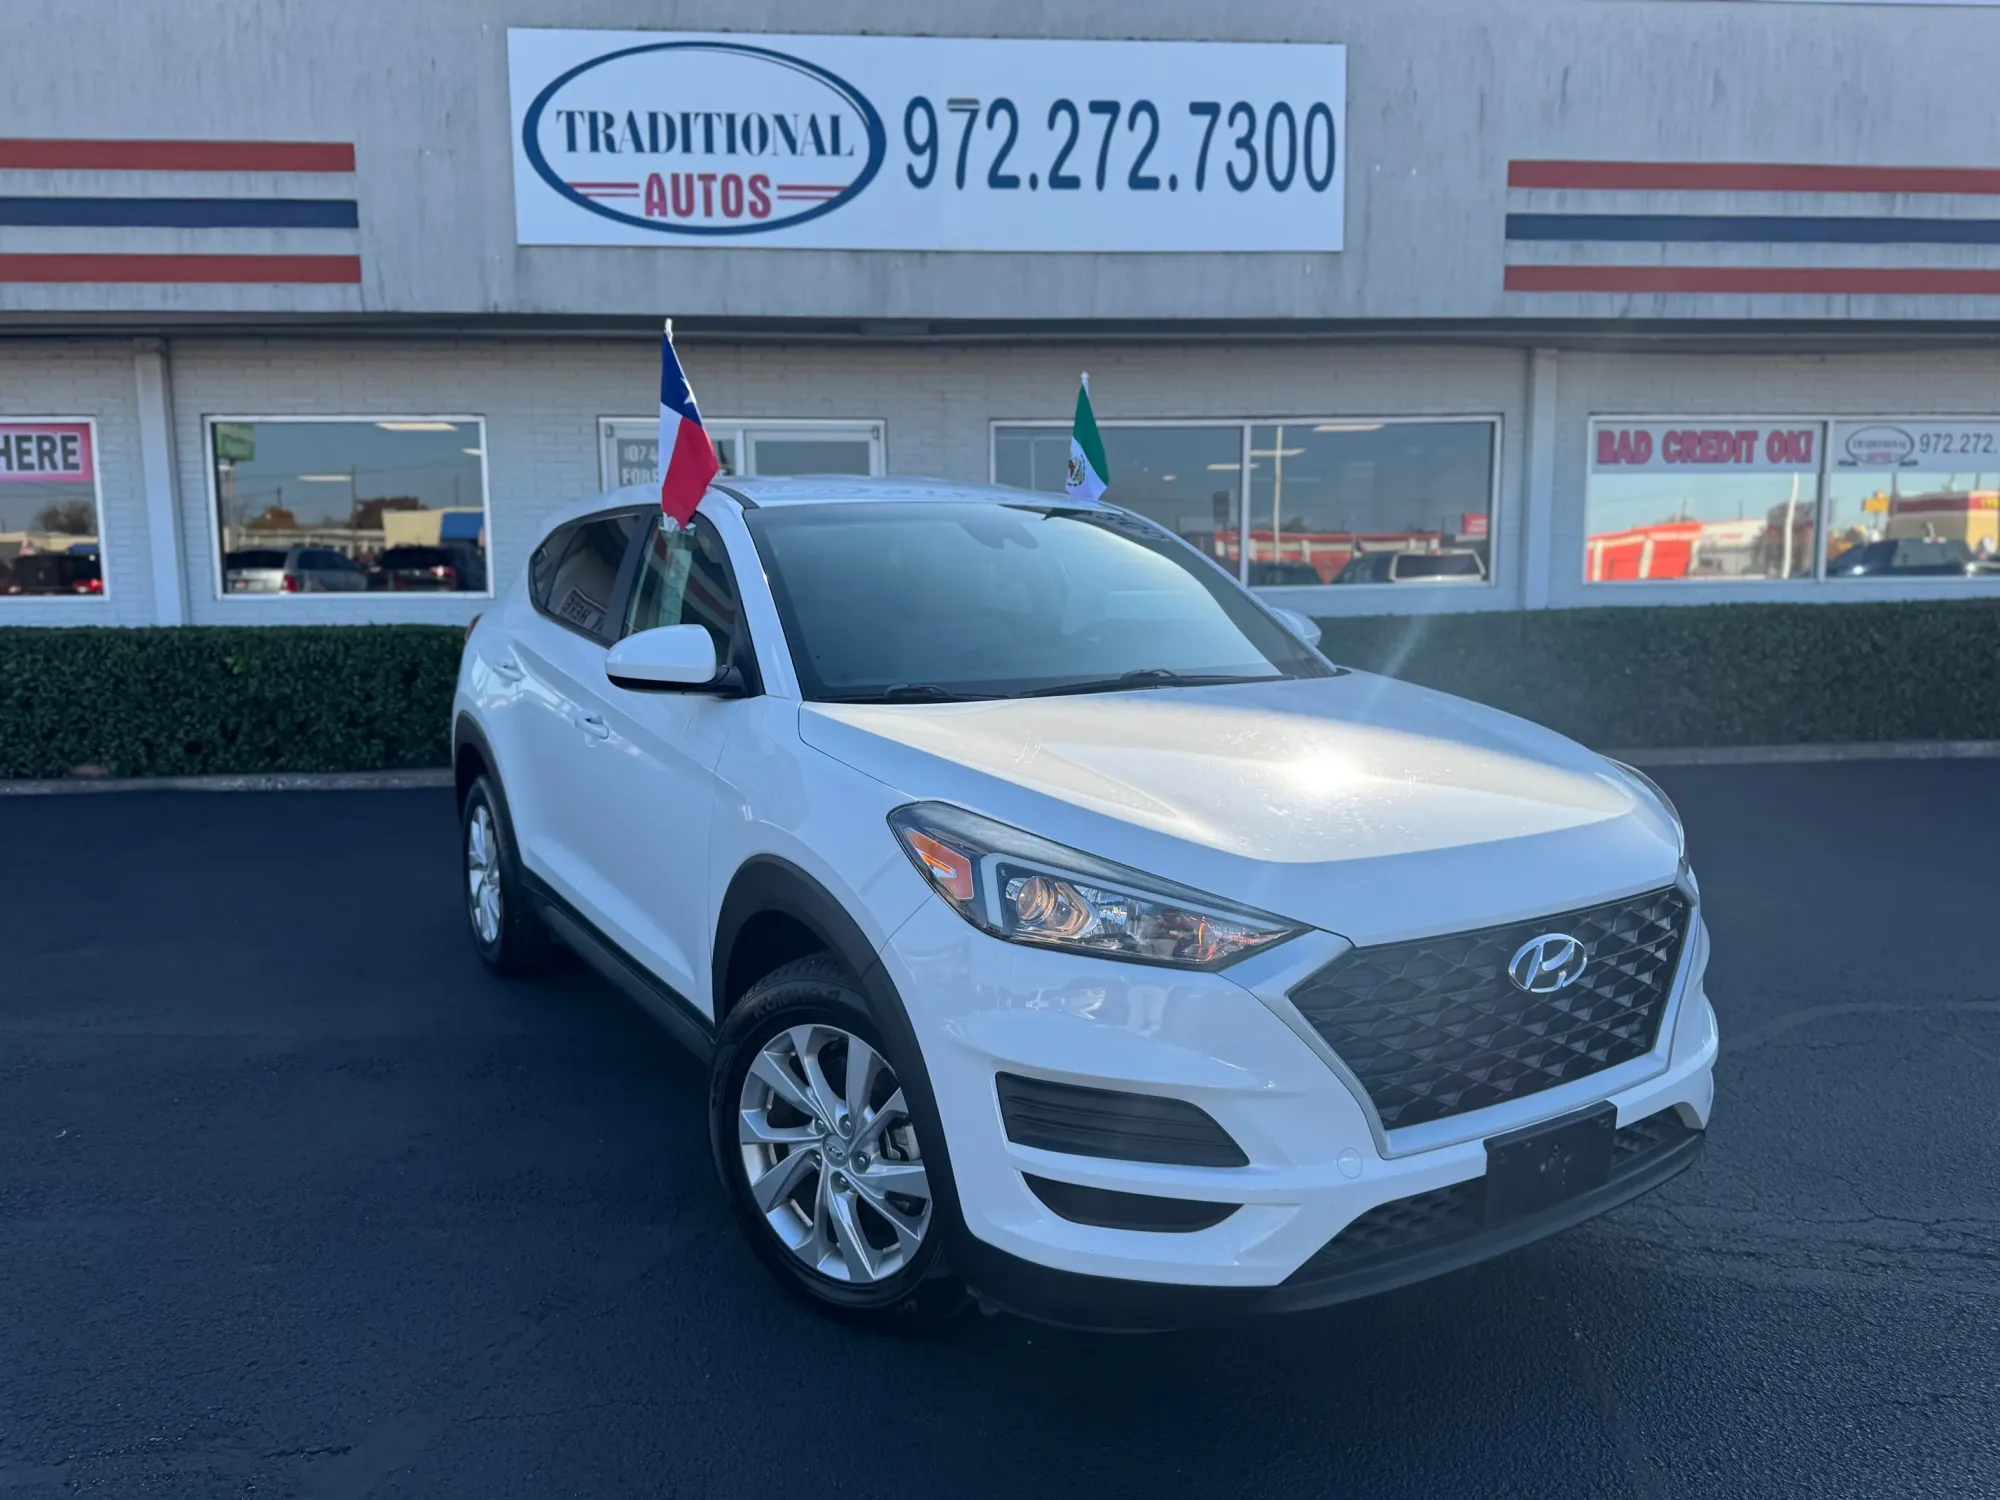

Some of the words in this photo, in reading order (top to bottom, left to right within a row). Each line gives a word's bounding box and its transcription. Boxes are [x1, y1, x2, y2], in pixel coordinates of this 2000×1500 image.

[556, 109, 853, 157] TRADITIONAL
[903, 96, 1337, 193] 972.272.7300
[645, 173, 772, 218] AUTOS
[0, 434, 81, 471] HERE
[1597, 430, 1653, 464] BAD
[1662, 430, 1759, 464] CREDIT
[1766, 430, 1814, 464] OK!
